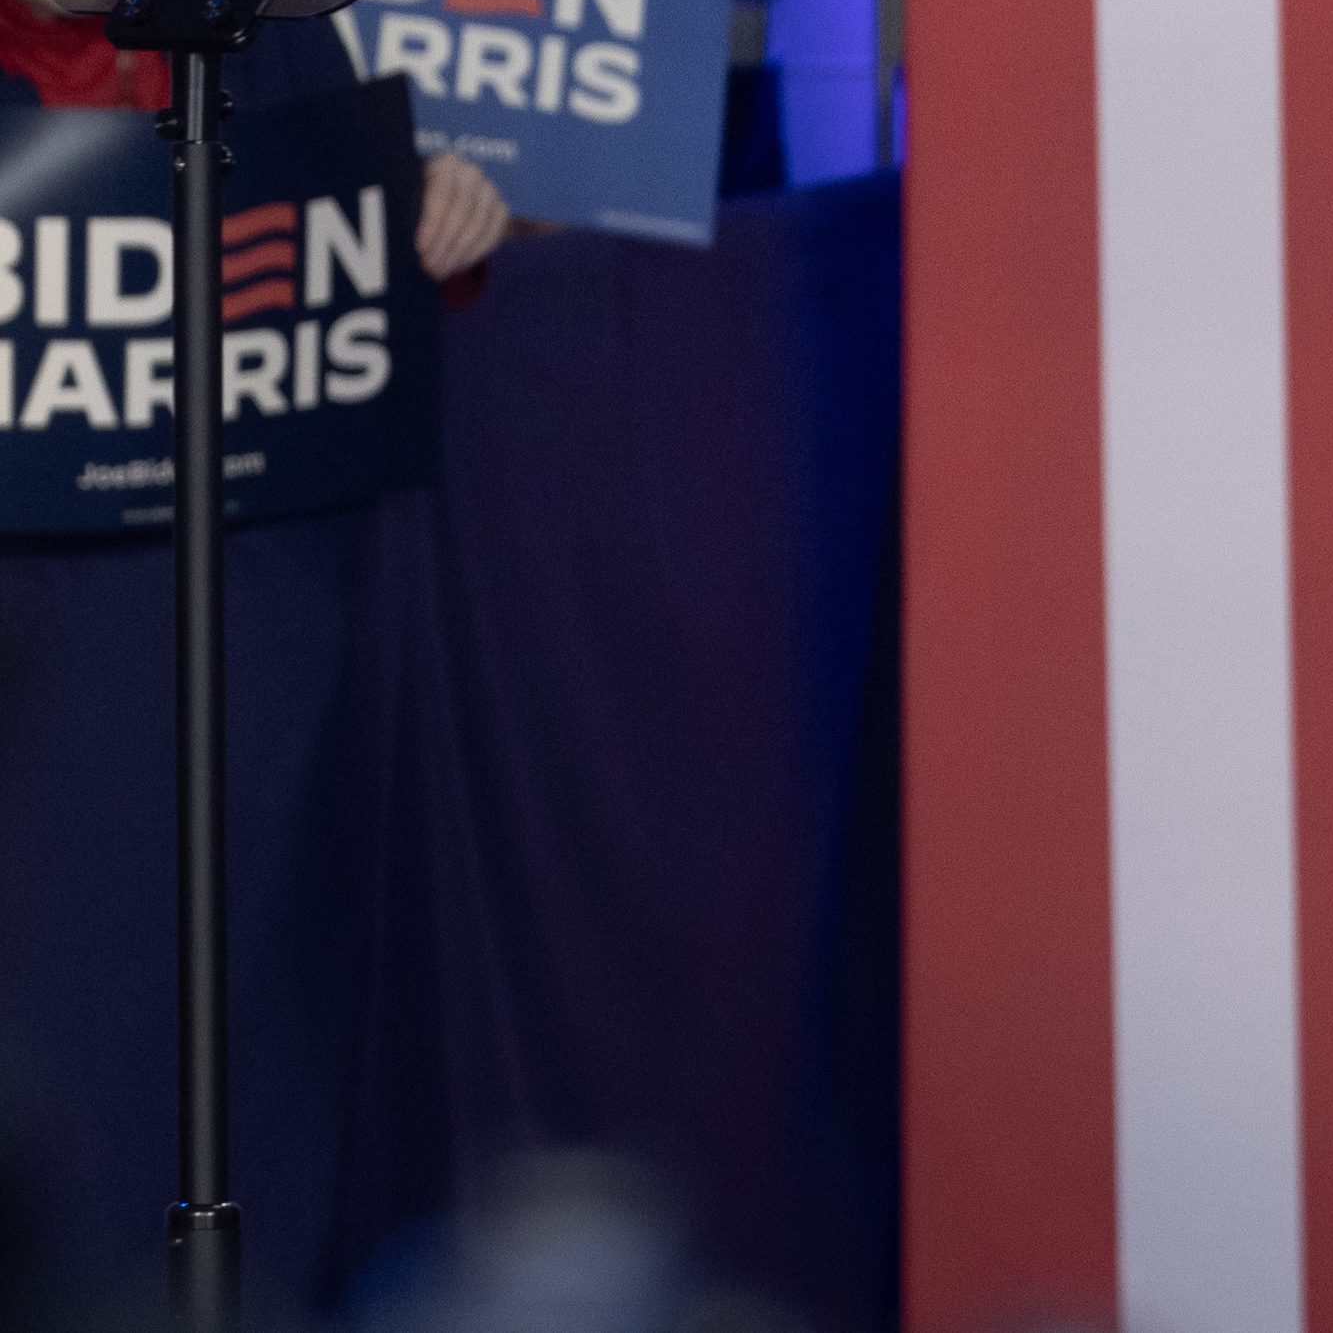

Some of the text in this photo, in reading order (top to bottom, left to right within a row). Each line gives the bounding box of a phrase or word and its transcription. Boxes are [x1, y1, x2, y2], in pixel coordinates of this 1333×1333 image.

[328, 7, 642, 125] RRIS
[0, 183, 390, 329] IDEN
[0, 307, 393, 431] ARRIS
